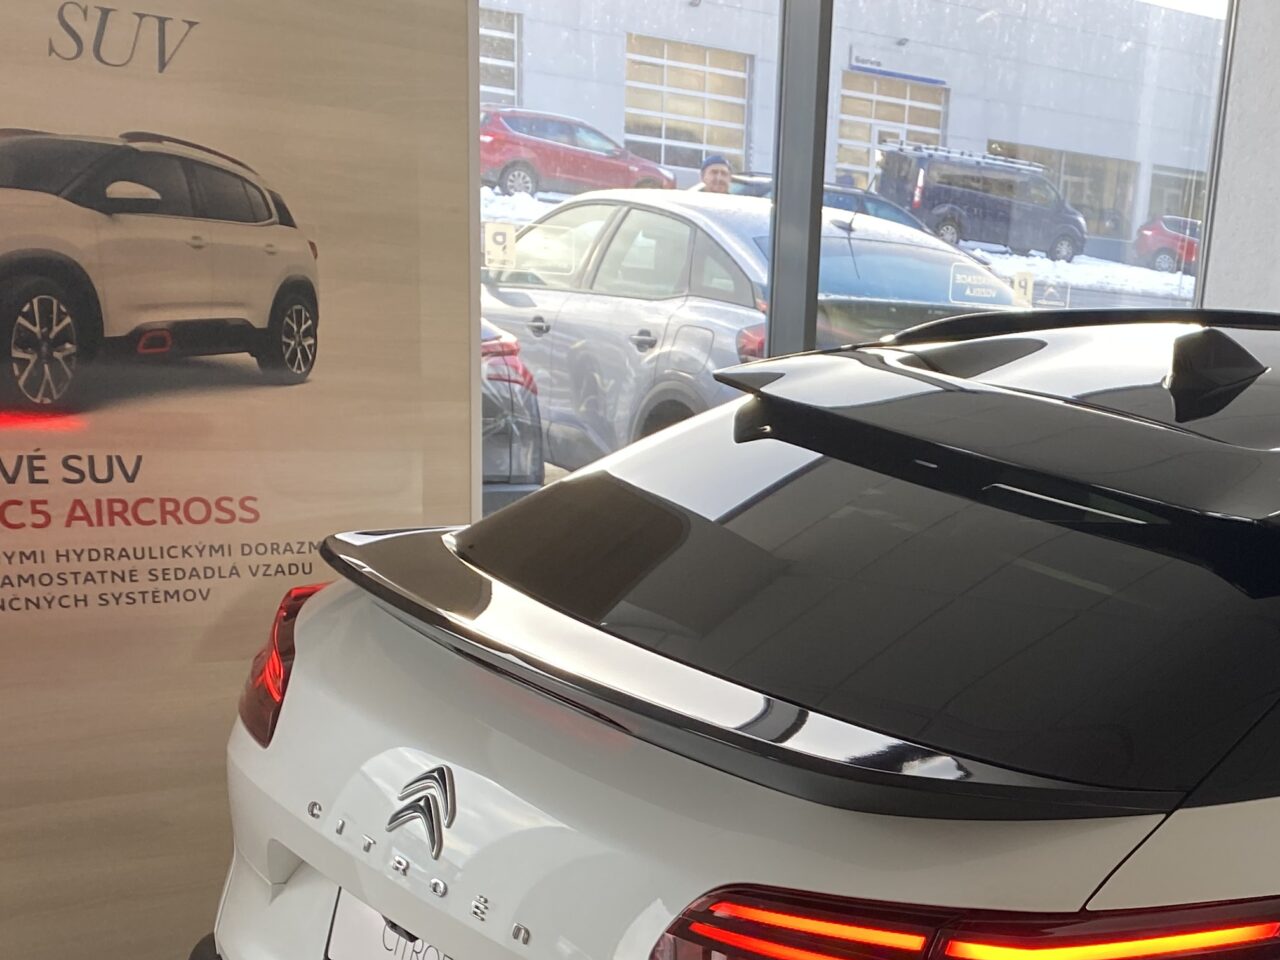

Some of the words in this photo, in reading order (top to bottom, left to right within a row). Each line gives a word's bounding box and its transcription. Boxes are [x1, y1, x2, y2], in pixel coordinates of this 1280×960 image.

[48, 0, 199, 74] SUV
[61, 454, 143, 485] SUV
[0, 499, 52, 530] C5
[64, 495, 261, 528] AIRCROSS
[56, 541, 232, 563] HYDRAULICKÝMI
[148, 563, 241, 582] SEDADLÁ
[249, 562, 313, 577] VZADU
[98, 588, 211, 606] SYSTÉMOV
